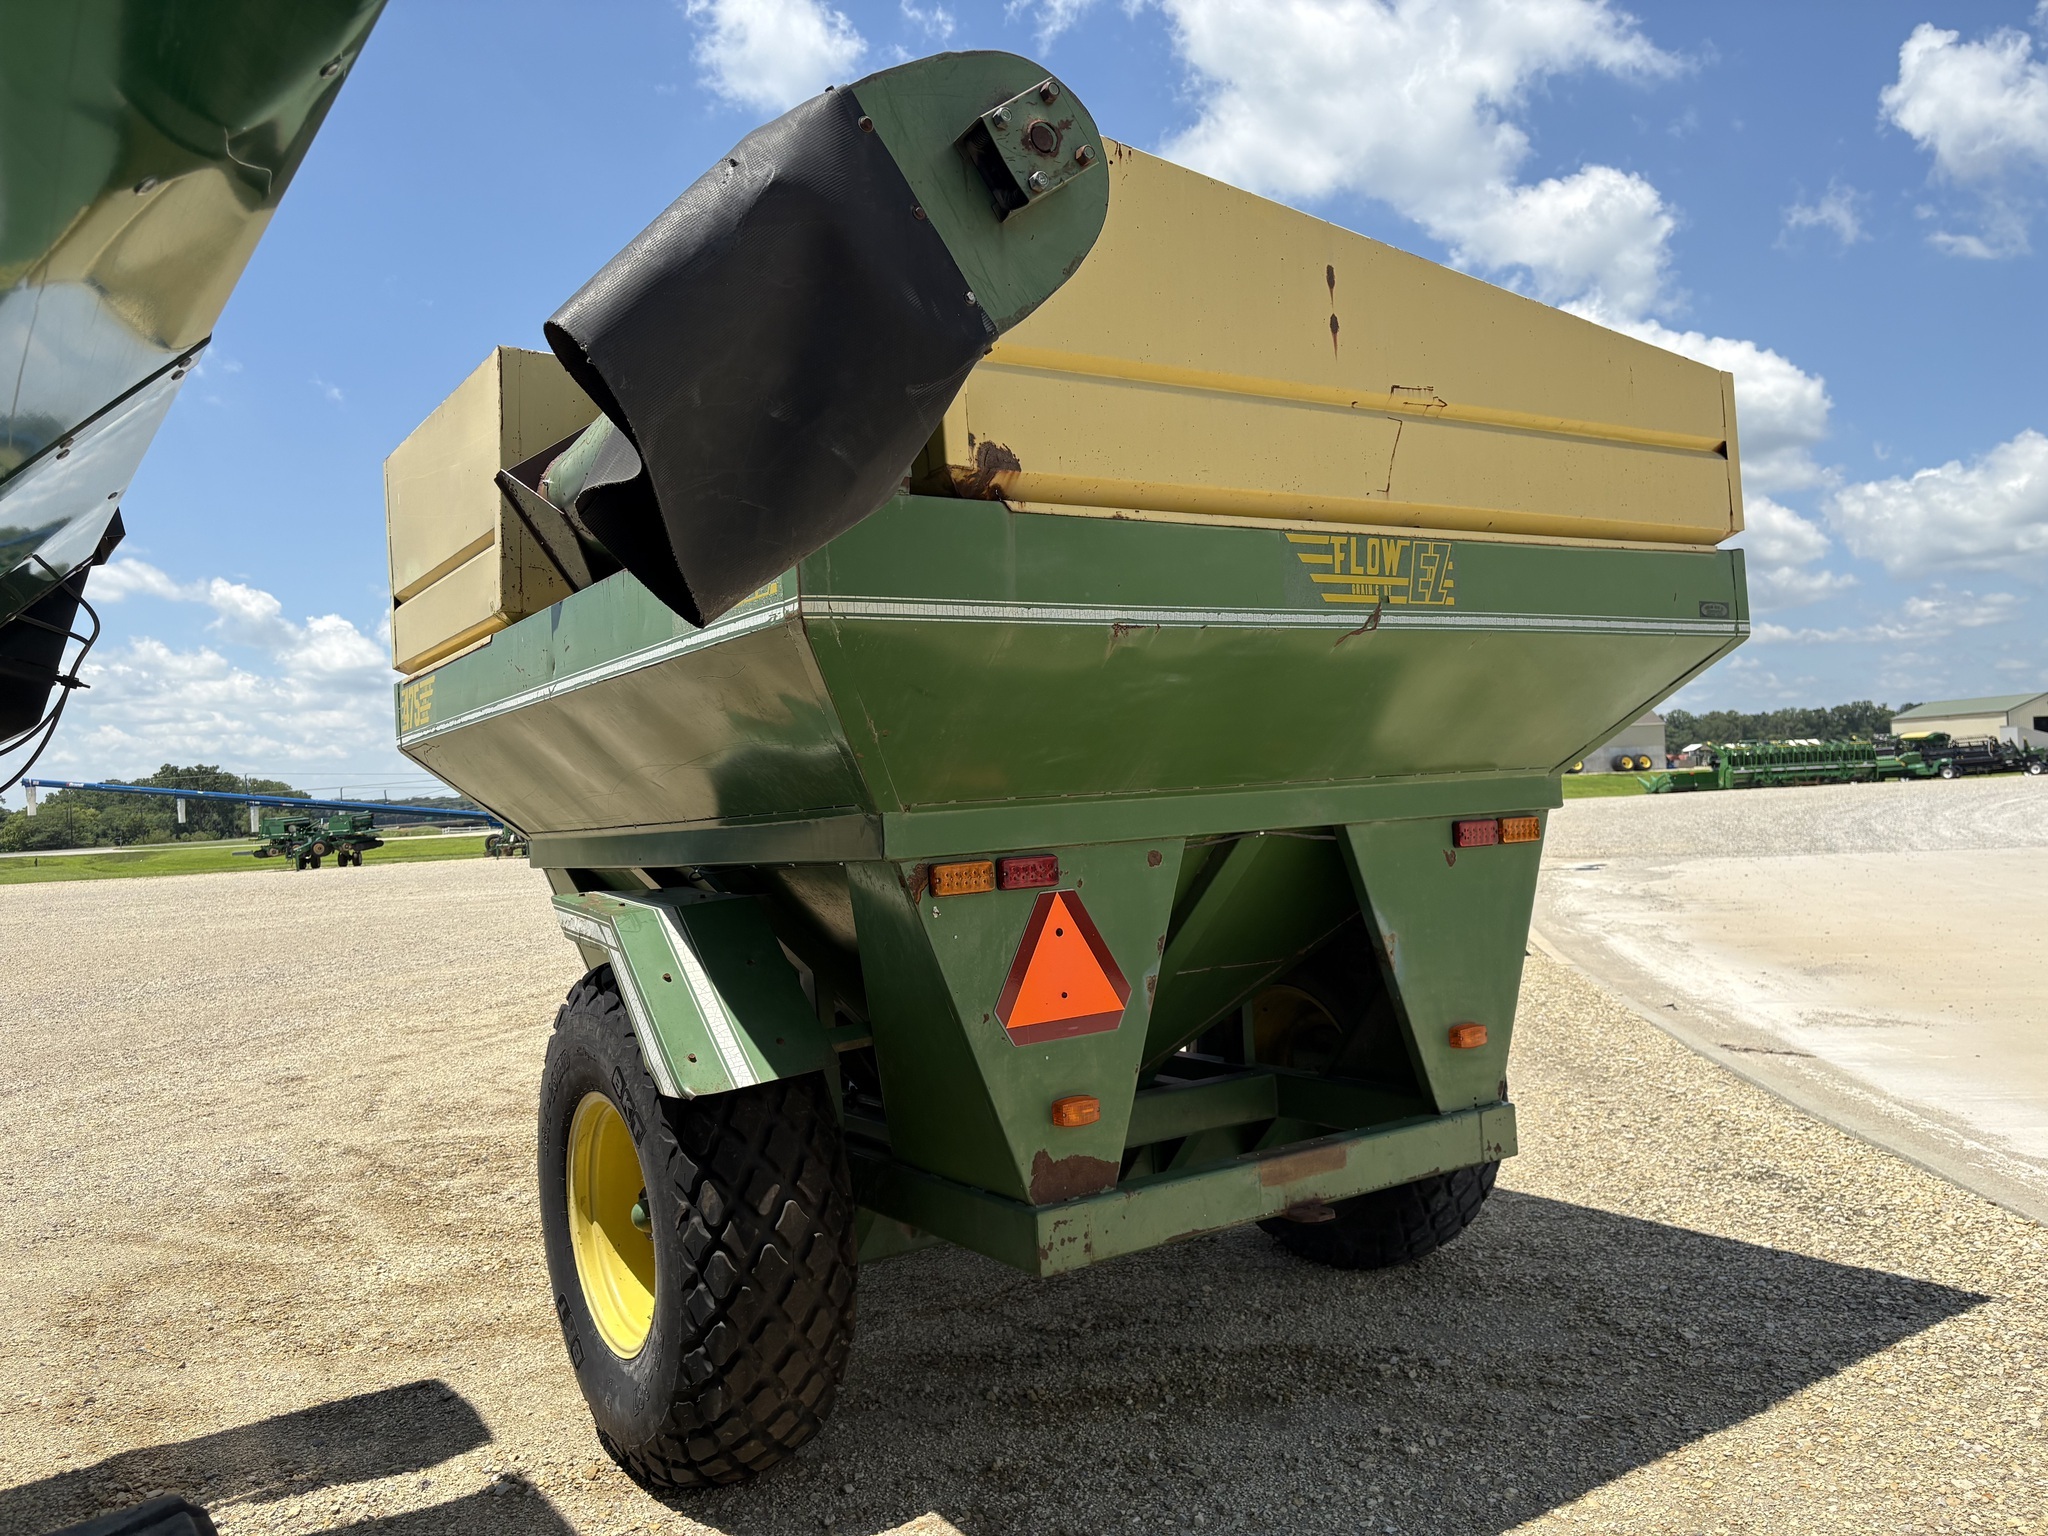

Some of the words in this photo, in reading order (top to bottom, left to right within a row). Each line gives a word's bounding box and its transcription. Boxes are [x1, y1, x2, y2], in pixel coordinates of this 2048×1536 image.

[1330, 536, 1411, 576] FLOW
[1409, 541, 1452, 604] EZ
[1351, 583, 1373, 596] GRAIN
[1375, 584, 1392, 597] CRT
[611, 1065, 648, 1148] BKT
